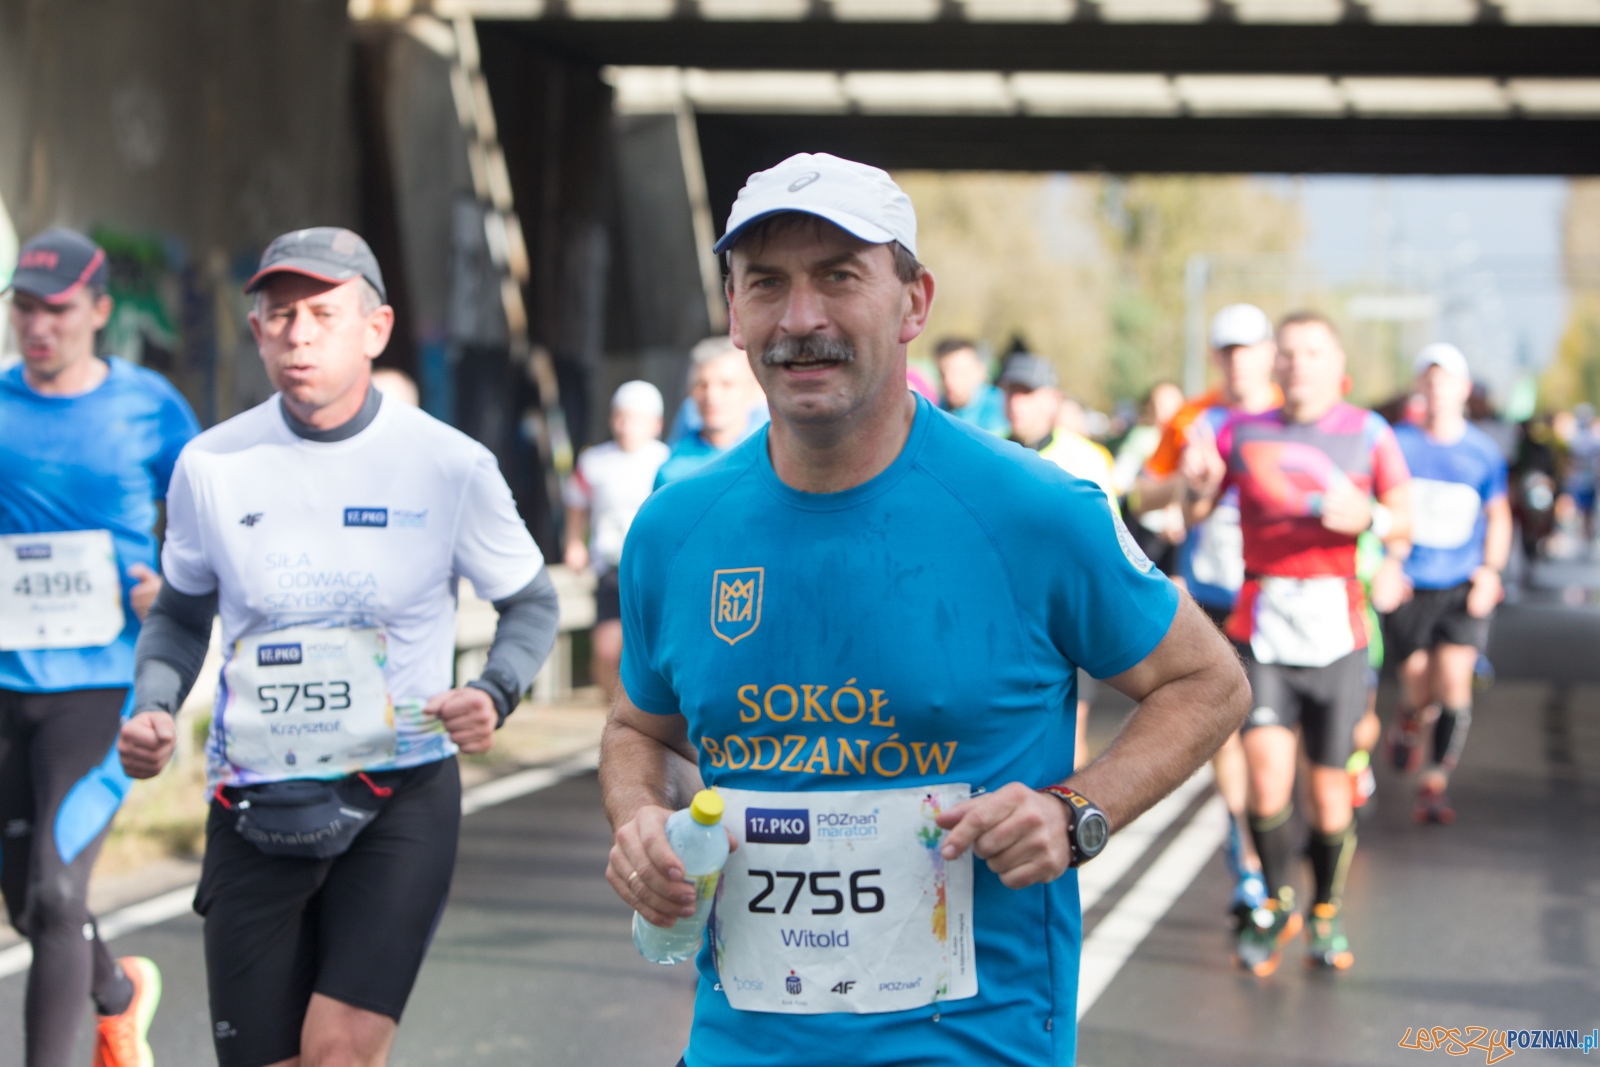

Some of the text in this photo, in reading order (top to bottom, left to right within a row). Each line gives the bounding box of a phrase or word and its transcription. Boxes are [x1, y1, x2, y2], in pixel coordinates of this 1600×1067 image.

[257, 680, 351, 714] 5753
[737, 677, 896, 728] SOKÓŁ
[270, 720, 341, 737] Krzysztof
[701, 733, 959, 778] BODZANÓW
[749, 816, 806, 835] 17.PKO
[817, 825, 879, 837] maraton
[747, 868, 886, 916] 2756
[780, 928, 850, 948] Witold
[830, 980, 857, 994] 4F
